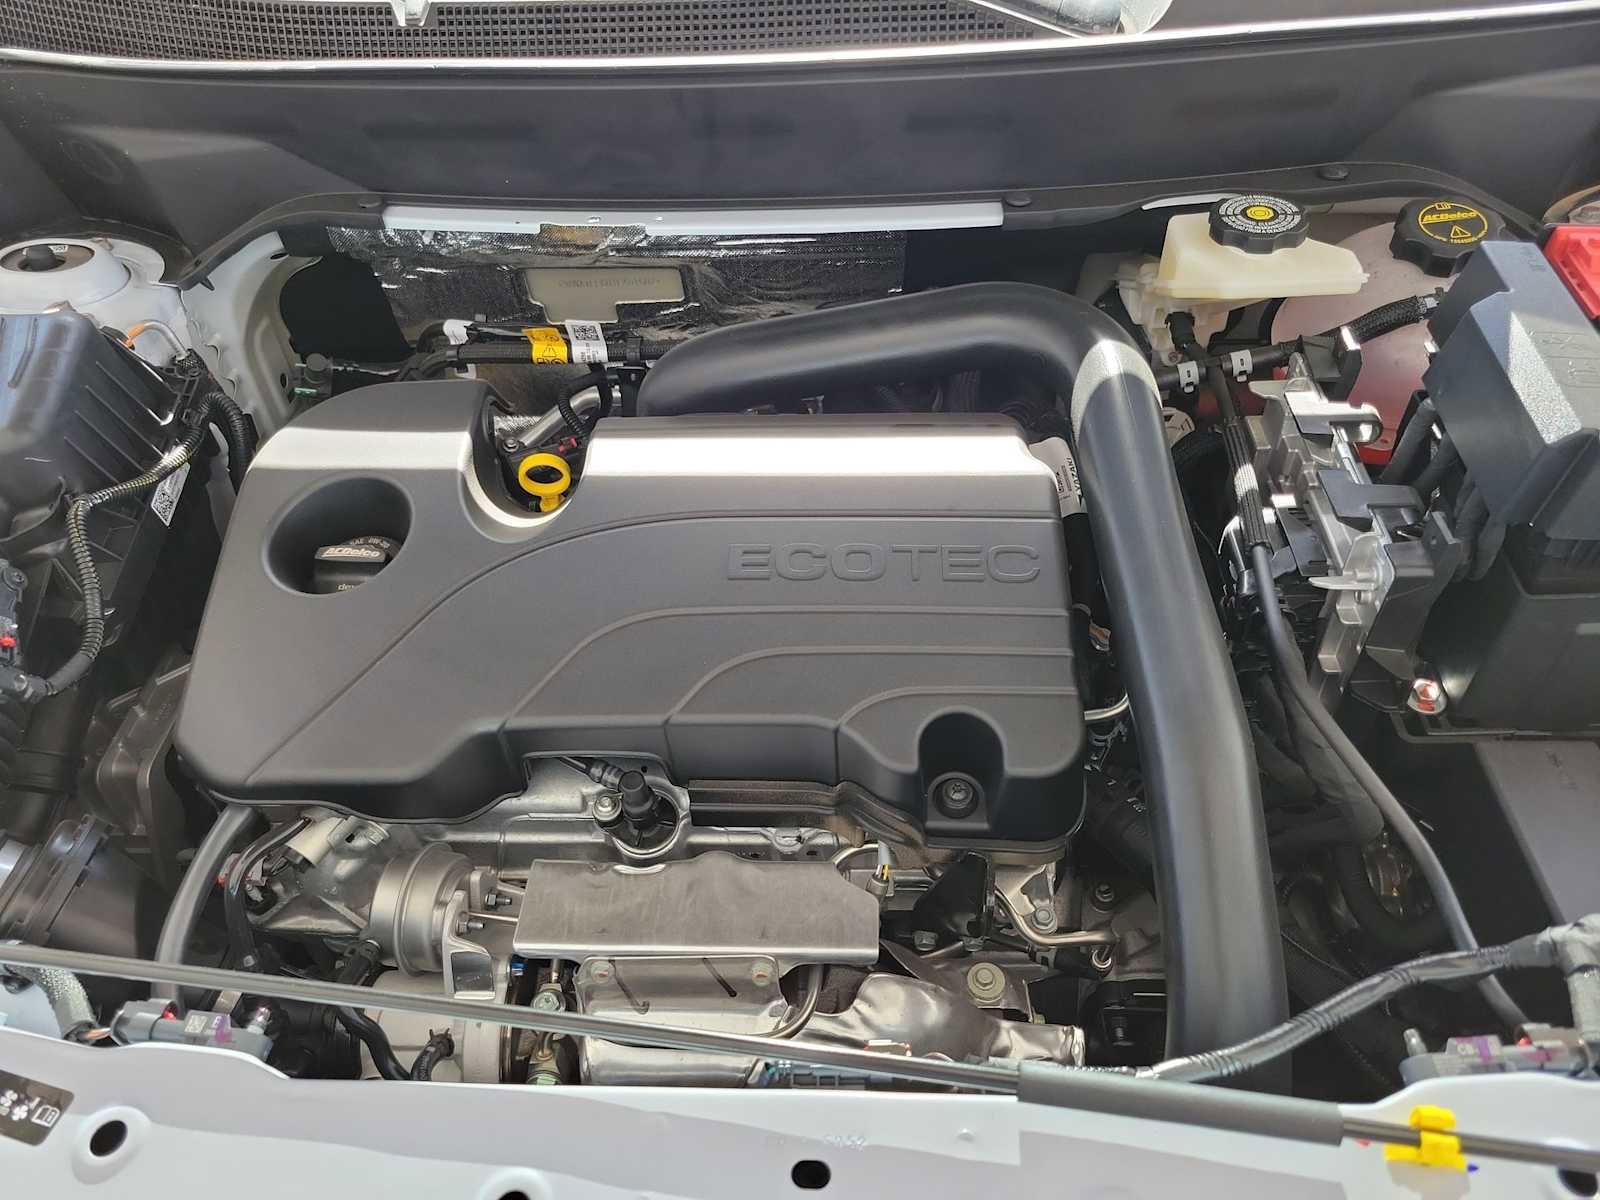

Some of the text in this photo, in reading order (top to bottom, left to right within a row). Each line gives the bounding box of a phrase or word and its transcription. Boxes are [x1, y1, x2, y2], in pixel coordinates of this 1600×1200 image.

[1422, 211, 1478, 224] ACDelco
[1066, 457, 1081, 493] YAZAKI
[321, 547, 381, 558] ACDelco
[727, 543, 1040, 583] ECOTEC
